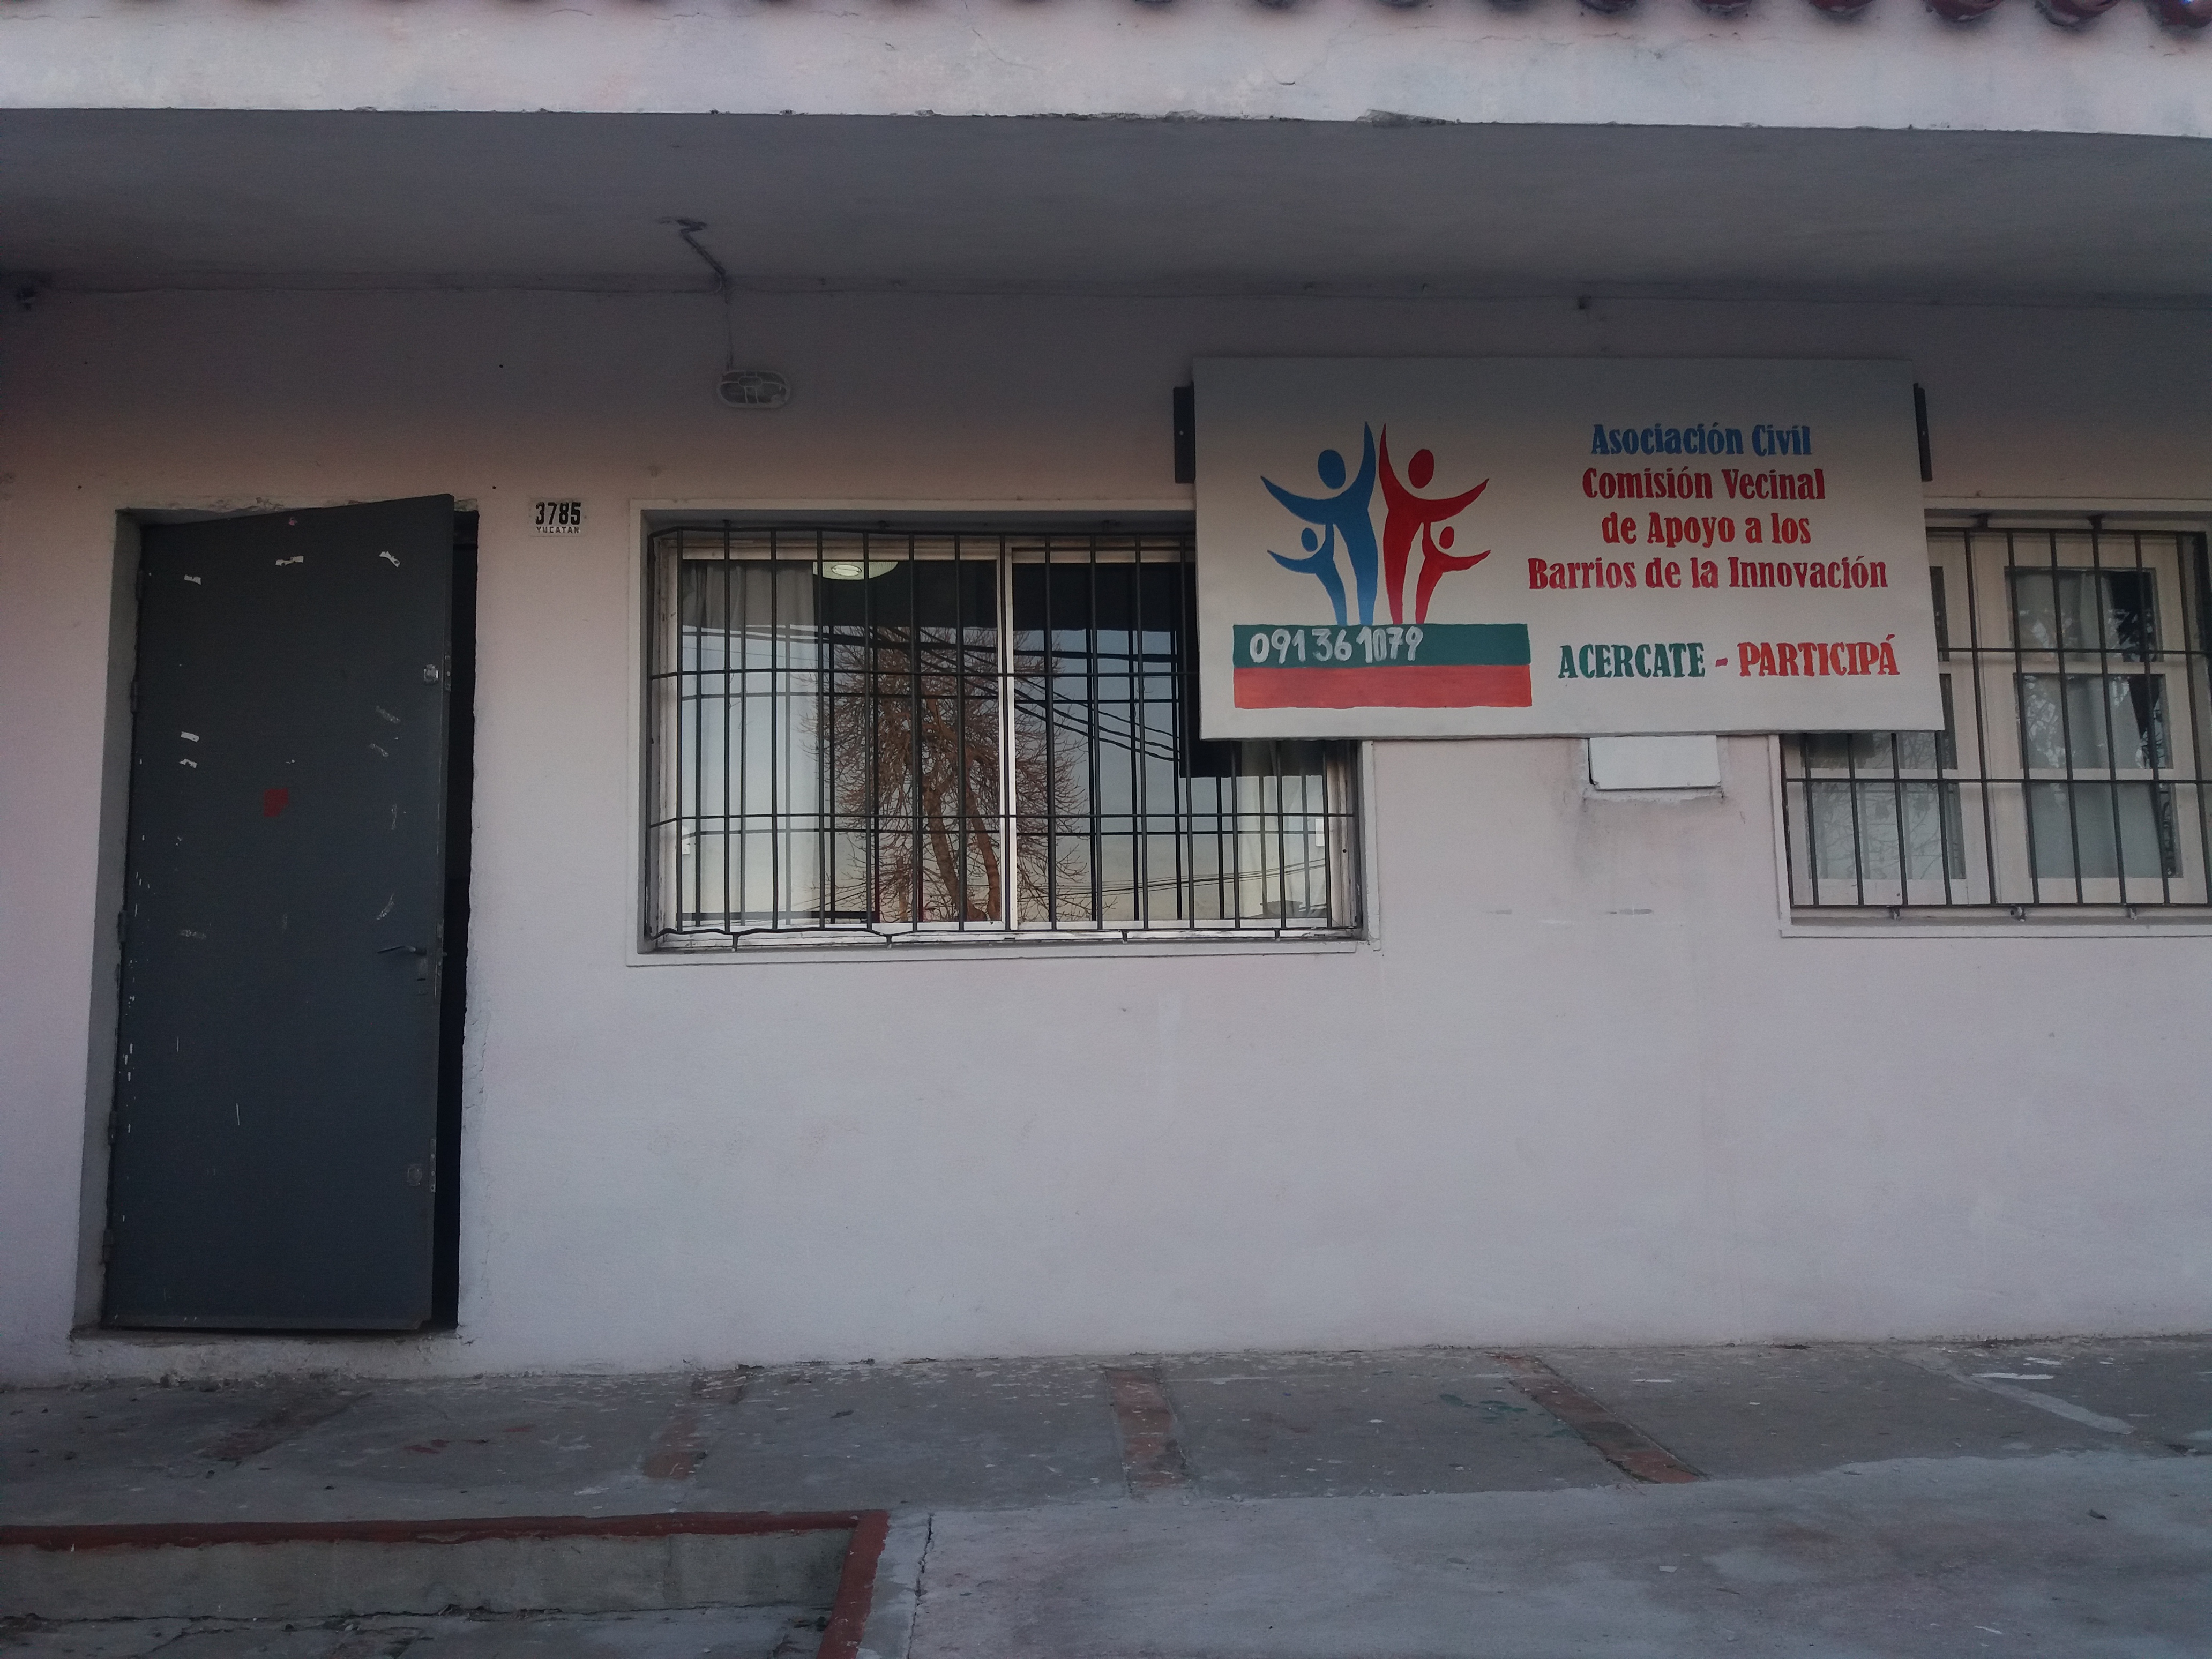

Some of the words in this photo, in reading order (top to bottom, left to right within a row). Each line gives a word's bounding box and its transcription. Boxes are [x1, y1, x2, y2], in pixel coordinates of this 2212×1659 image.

[1591, 423, 1744, 455] Asociación
[1752, 424, 1812, 455] Civil
[1582, 466, 1713, 499] Comisión
[1721, 469, 1826, 500] Vecinal
[535, 502, 581, 525] 3785
[1602, 512, 1637, 544] de
[1647, 512, 1735, 548] Apoyo
[1745, 518, 1763, 544] a
[1772, 513, 1811, 544] los
[1528, 558, 1636, 589] Barrios
[1645, 558, 1682, 588] de
[1691, 558, 1719, 589] la
[1728, 556, 1888, 589] Innovación
[1558, 642, 1706, 678] ACERCATE
[1737, 634, 1900, 677] PARTICIPÁ
